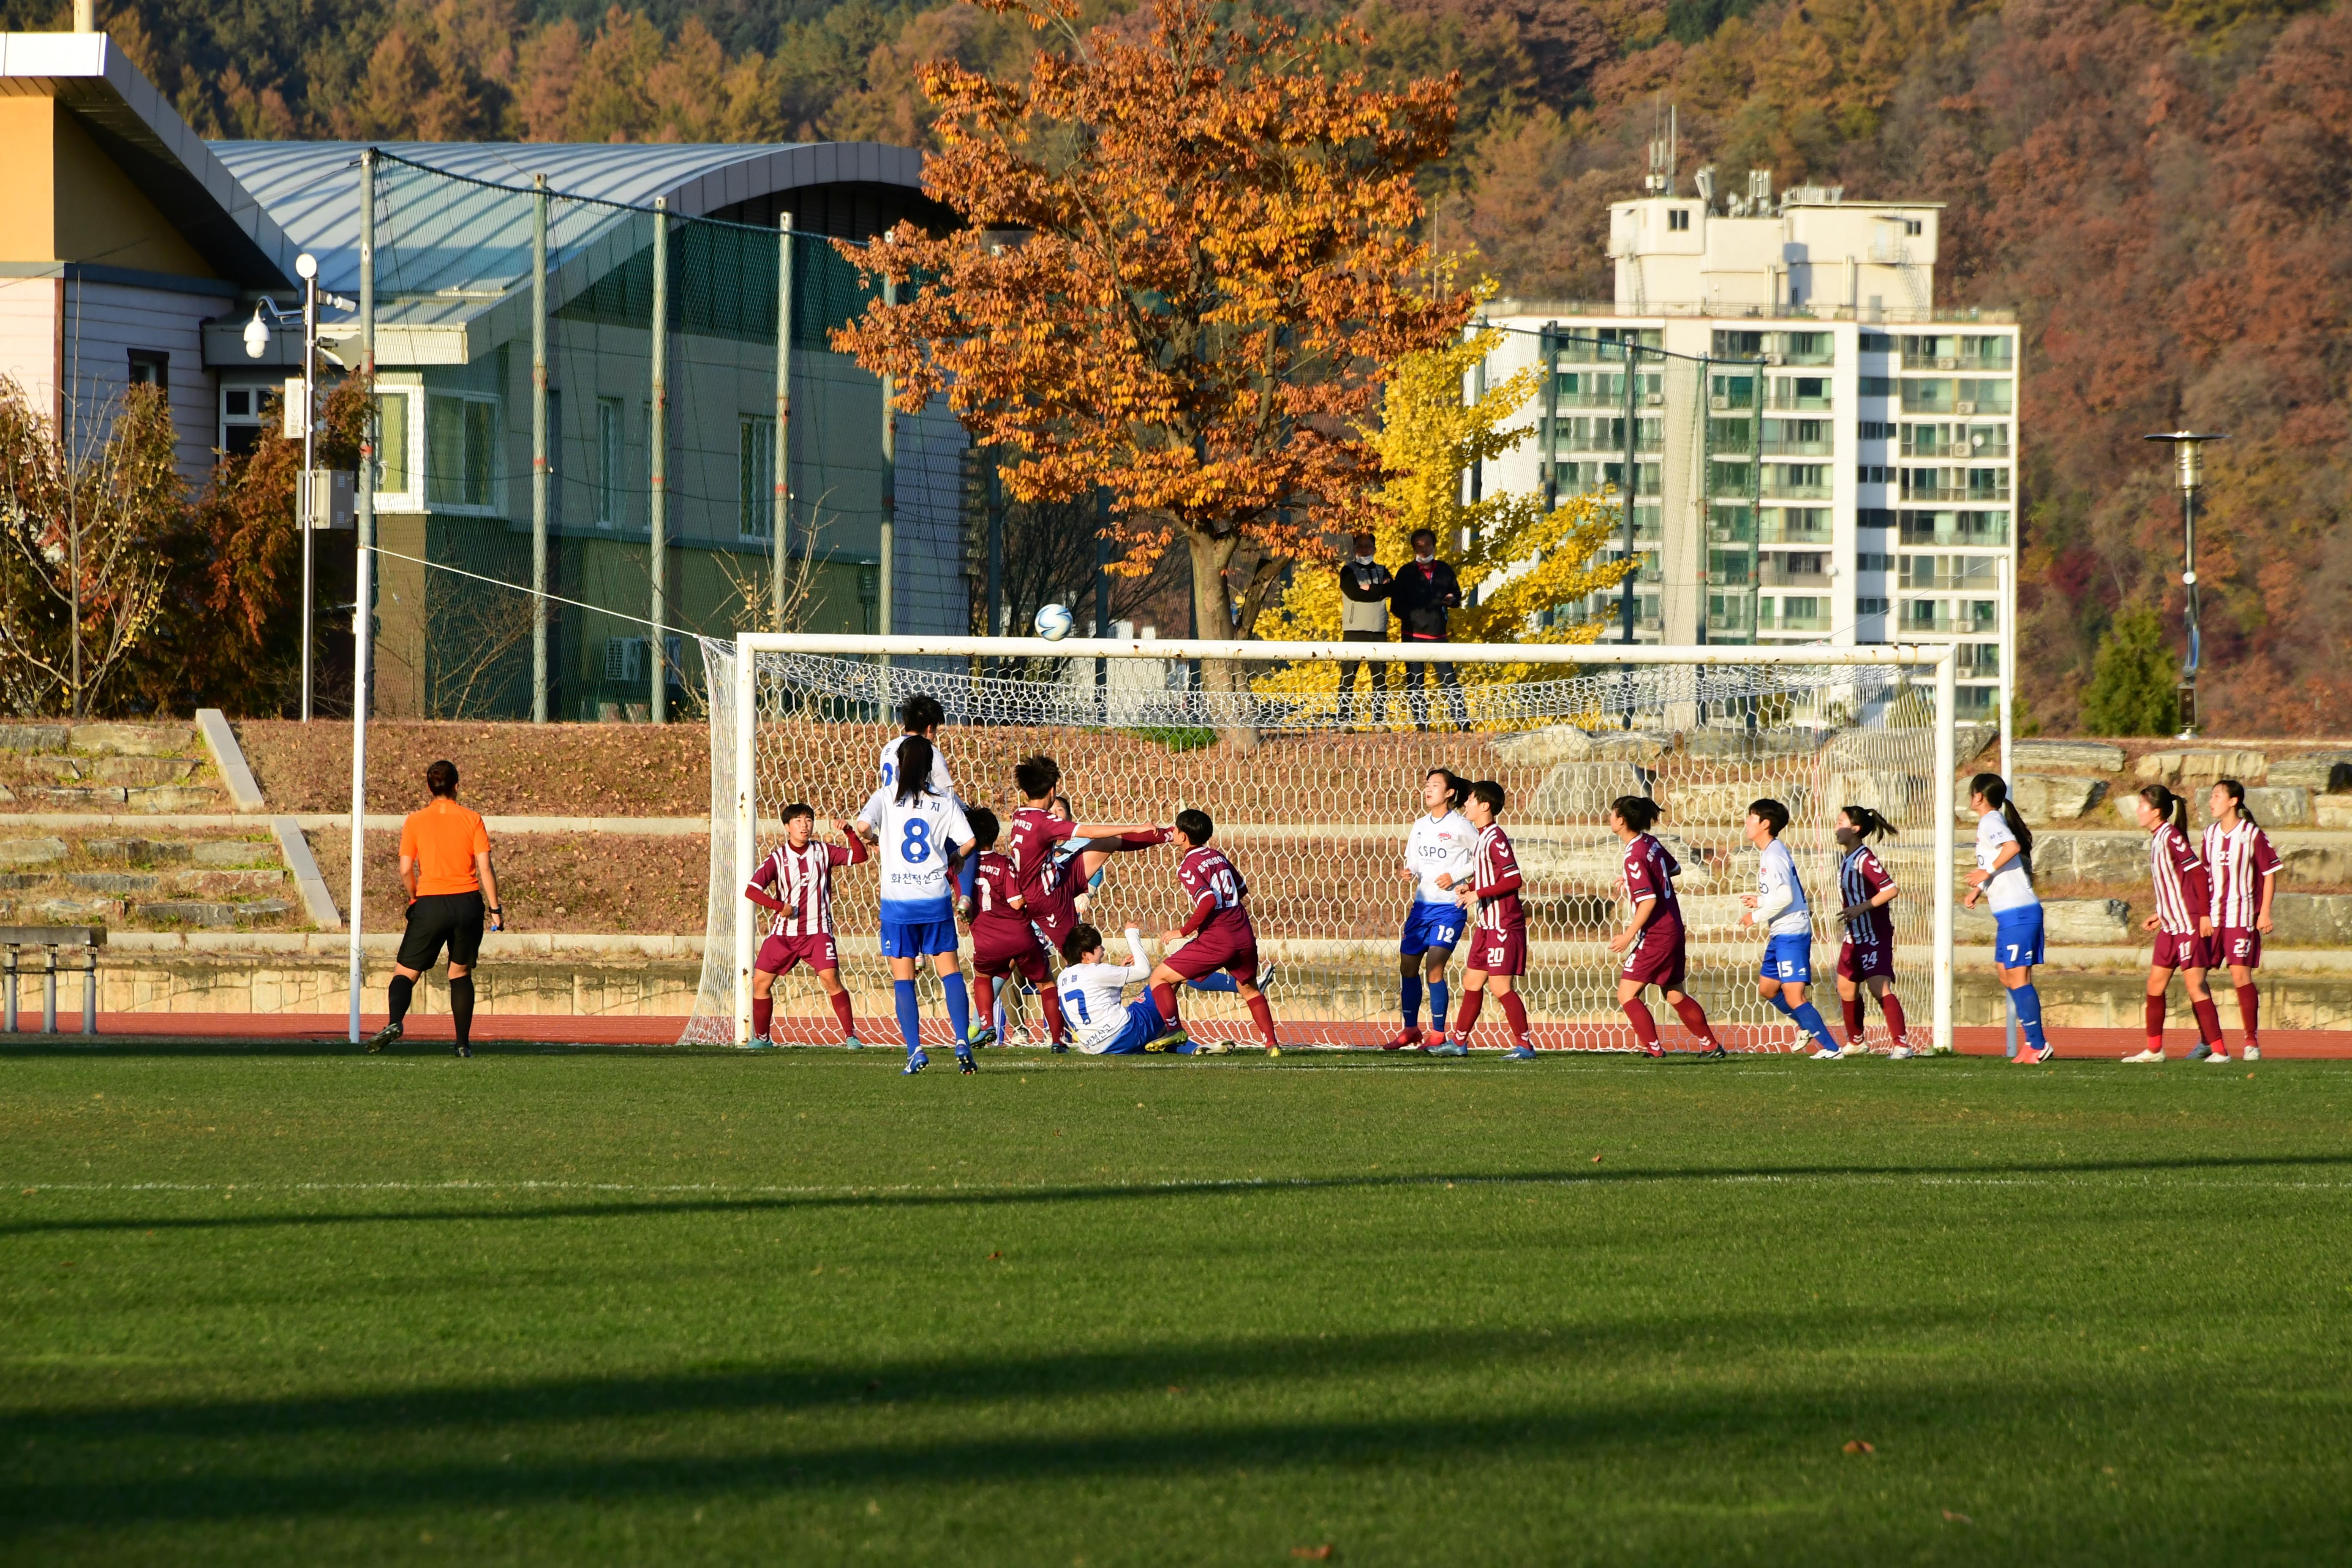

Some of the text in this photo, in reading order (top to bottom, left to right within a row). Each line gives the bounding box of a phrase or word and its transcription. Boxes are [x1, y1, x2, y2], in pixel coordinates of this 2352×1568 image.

[901, 817, 931, 863] 8
[2217, 851, 2232, 866] 23
[801, 872, 809, 886] 2
[1210, 869, 1239, 910] 19
[1437, 925, 1455, 943] 12
[825, 942, 835, 956] 2
[2006, 945, 2018, 961] 7
[2178, 940, 2191, 958] 11
[2233, 938, 2251, 954] 23
[1487, 947, 1504, 963] 20
[1625, 953, 1636, 967] 8
[1862, 951, 1878, 968] 24
[1777, 961, 1793, 978] 15
[1059, 988, 1092, 1032] 17
